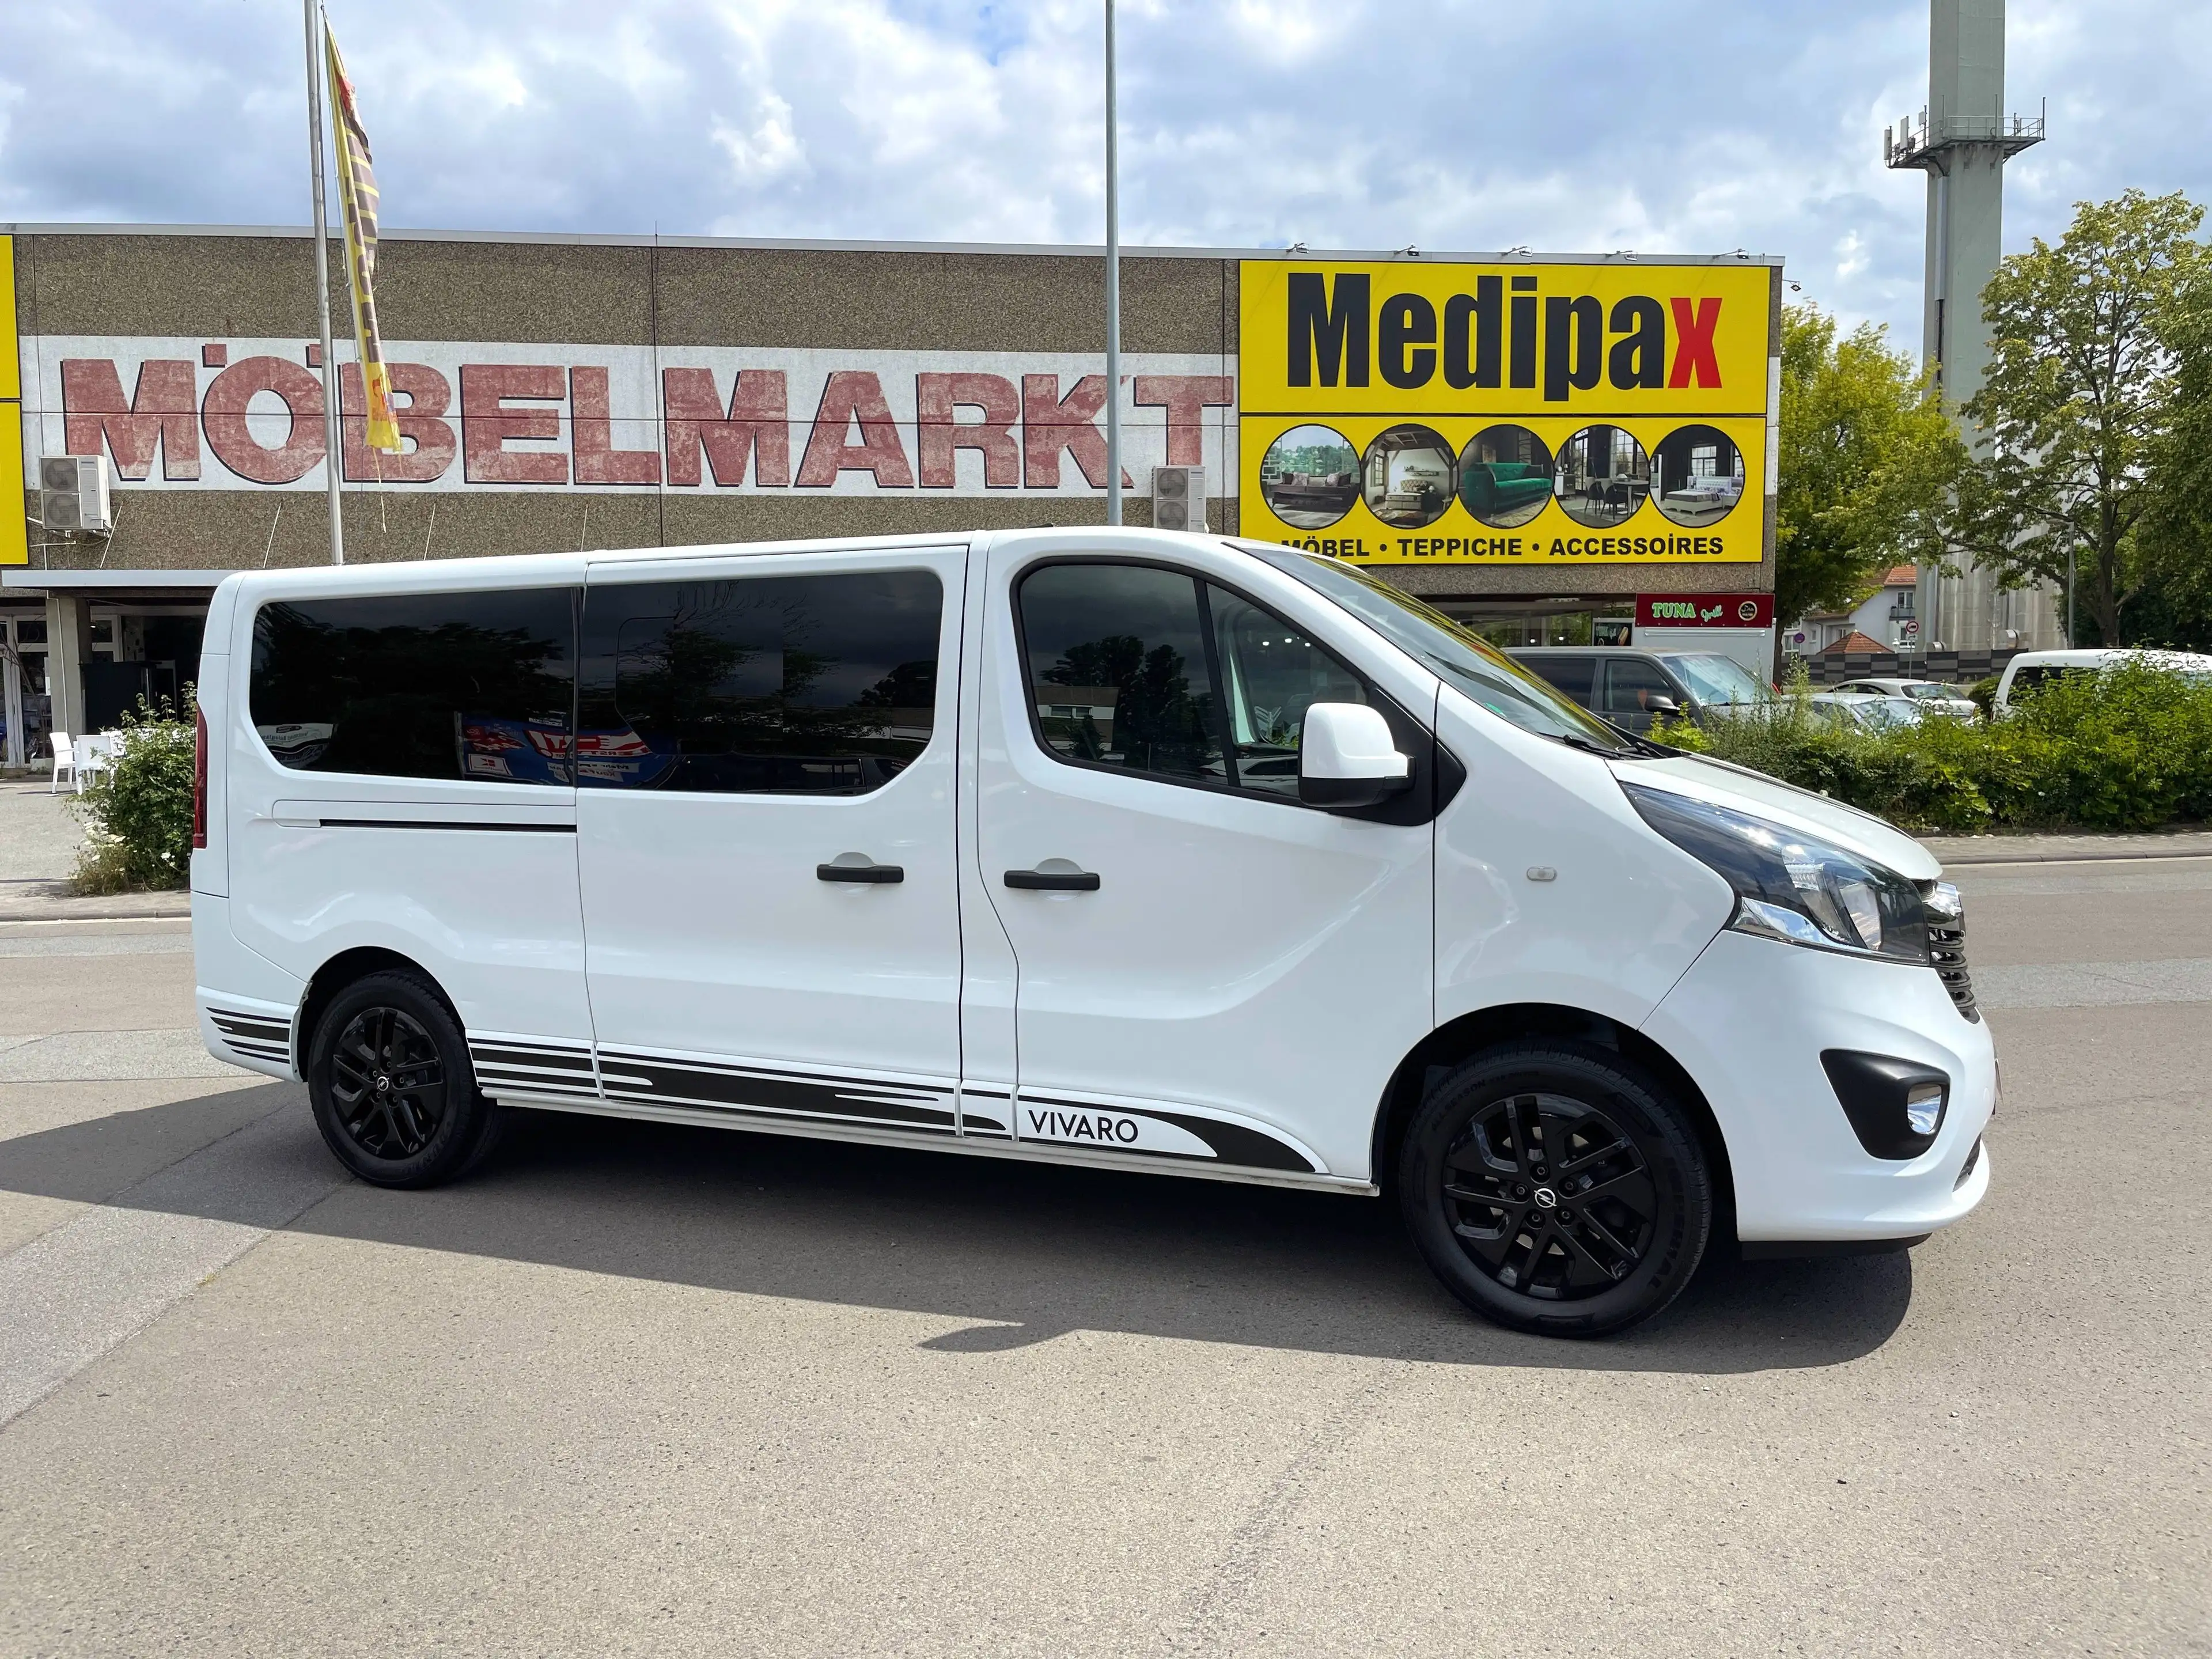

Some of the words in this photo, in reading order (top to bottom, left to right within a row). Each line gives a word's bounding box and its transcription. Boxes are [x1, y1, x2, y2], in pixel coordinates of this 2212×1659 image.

[1287, 272, 1722, 402] Medipax
[60, 343, 1234, 488] MÖBELMARKT
[1397, 538, 1522, 556] TEPPICHE
[1652, 603, 1696, 618] TUNA
[1028, 1109, 1138, 1143] VIVARO
